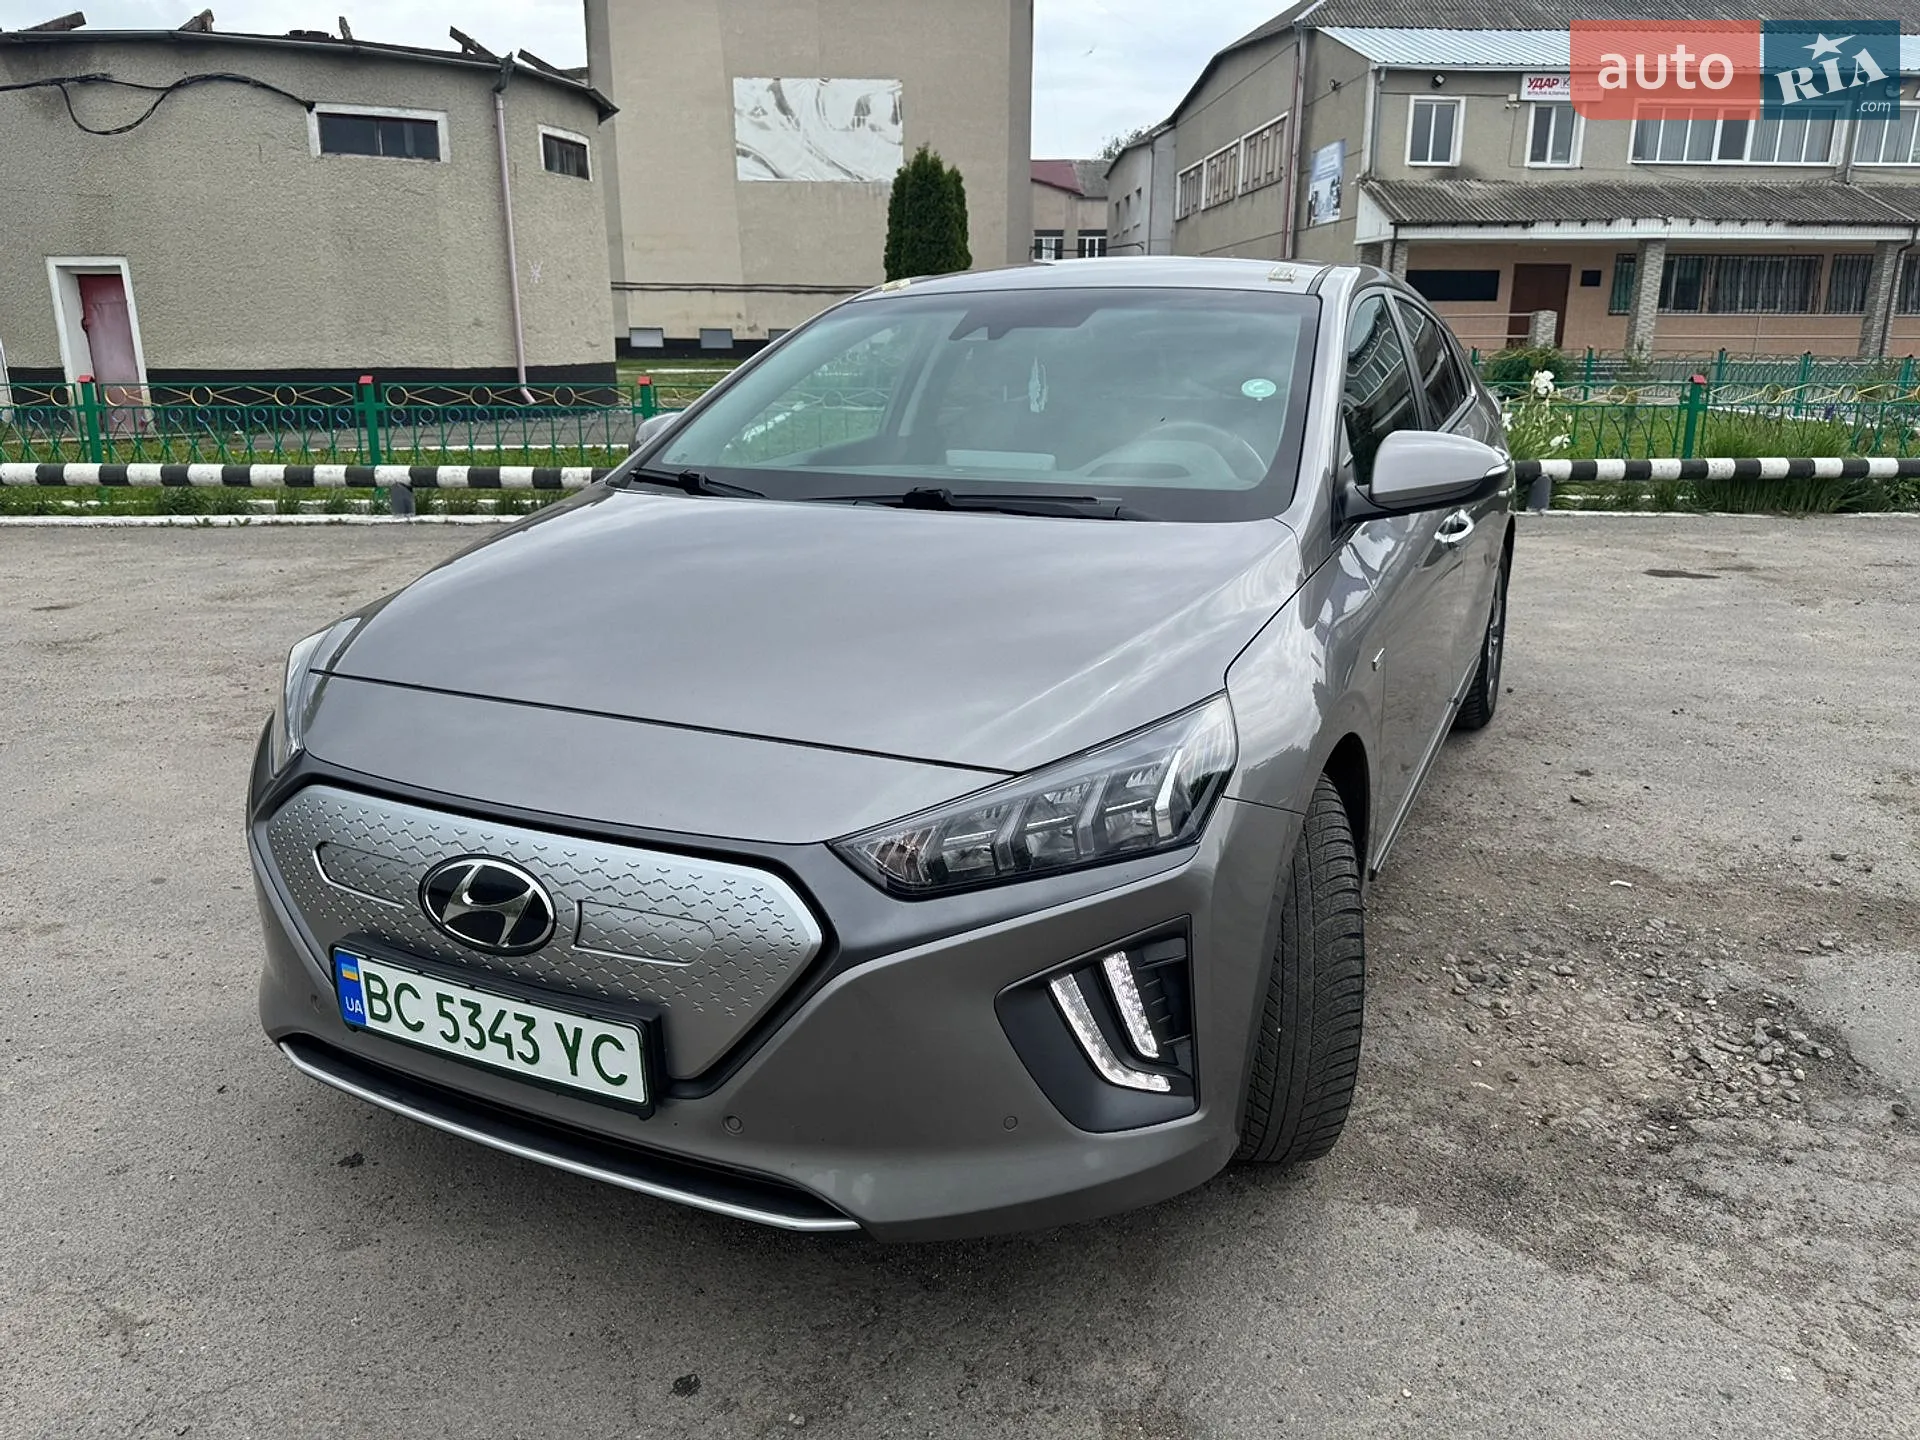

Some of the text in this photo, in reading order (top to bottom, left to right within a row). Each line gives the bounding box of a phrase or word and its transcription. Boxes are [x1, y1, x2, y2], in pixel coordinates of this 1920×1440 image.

[1527, 77, 1559, 89] УДАР
[345, 996, 364, 1015] UA
[363, 970, 628, 1086] BC 5343 YC
